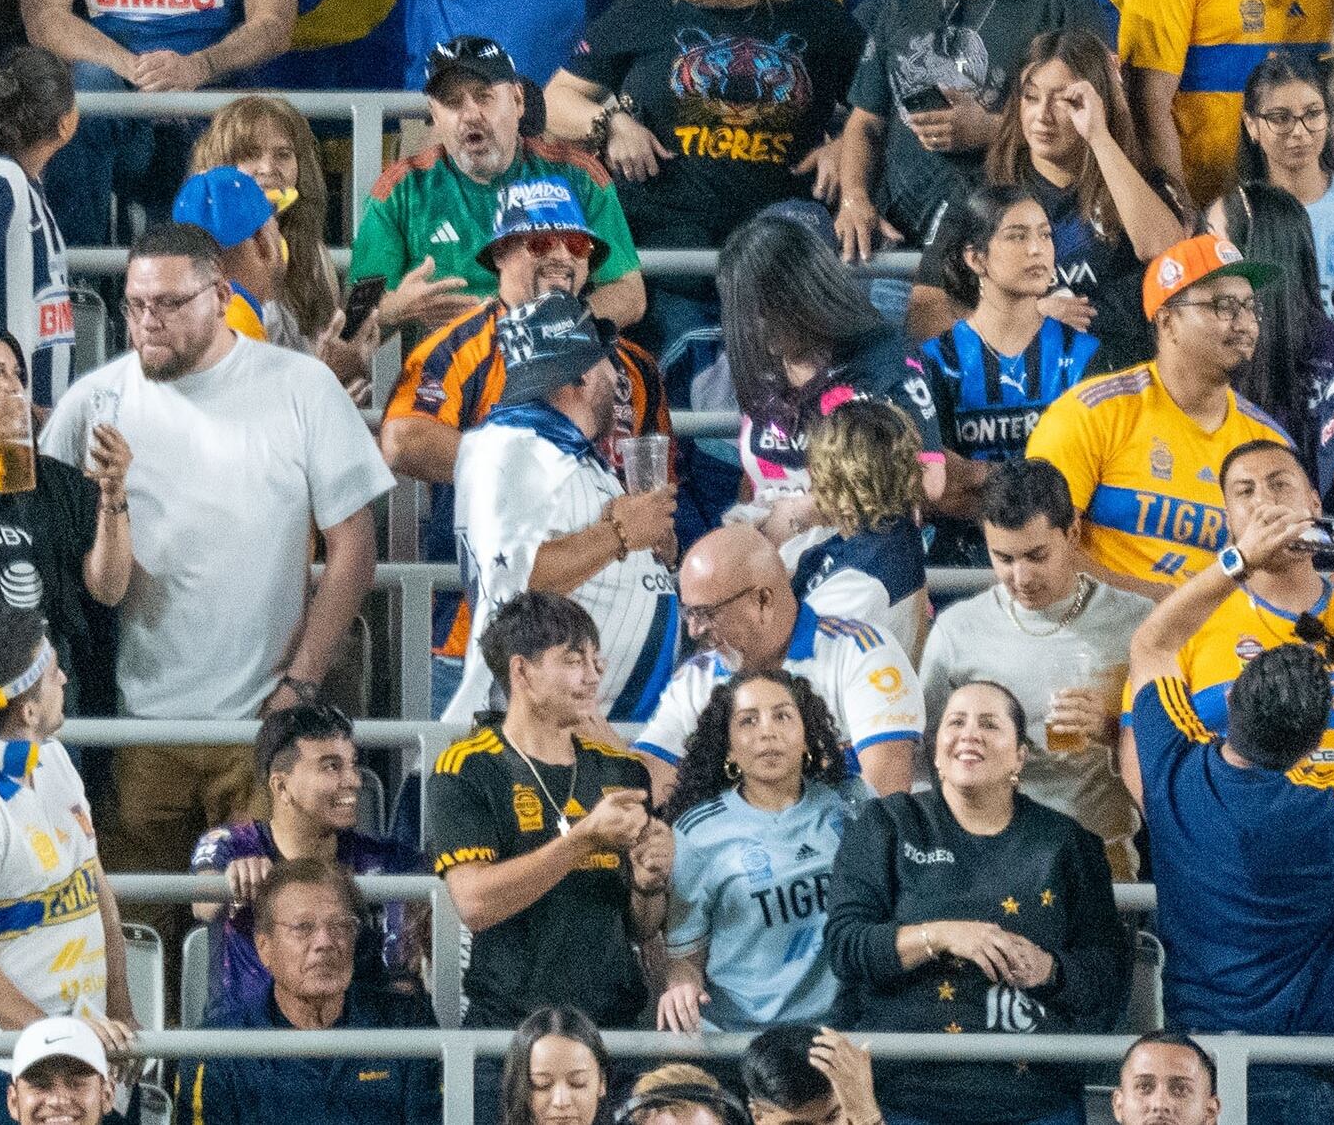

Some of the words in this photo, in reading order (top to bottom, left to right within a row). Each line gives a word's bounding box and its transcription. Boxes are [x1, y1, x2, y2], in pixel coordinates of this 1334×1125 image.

[675, 125, 793, 163] TIGRES
[508, 184, 571, 209] RAYADOS
[1136, 493, 1224, 549] TIGR
[904, 842, 955, 865] TIGRES
